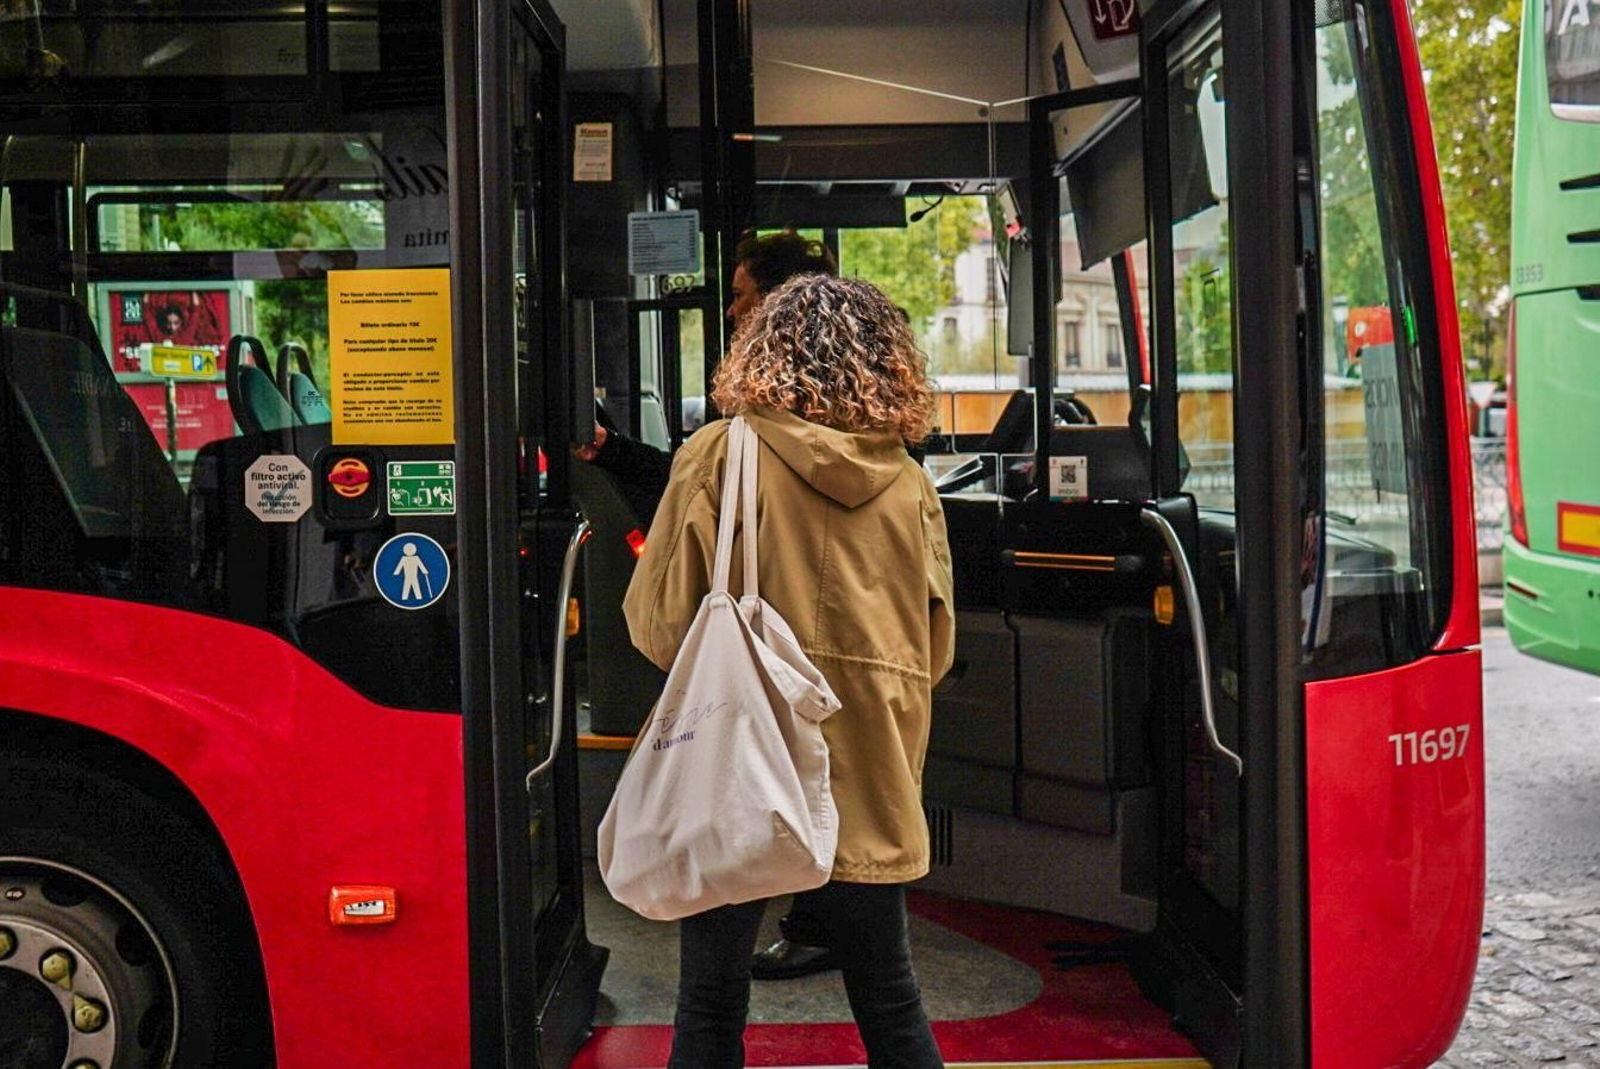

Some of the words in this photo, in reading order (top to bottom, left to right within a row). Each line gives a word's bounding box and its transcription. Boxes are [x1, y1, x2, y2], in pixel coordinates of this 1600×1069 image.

[268, 462, 288, 472] Con
[250, 472, 274, 480] filtro
[276, 472, 306, 480] activo
[1388, 723, 1470, 766] 11697
